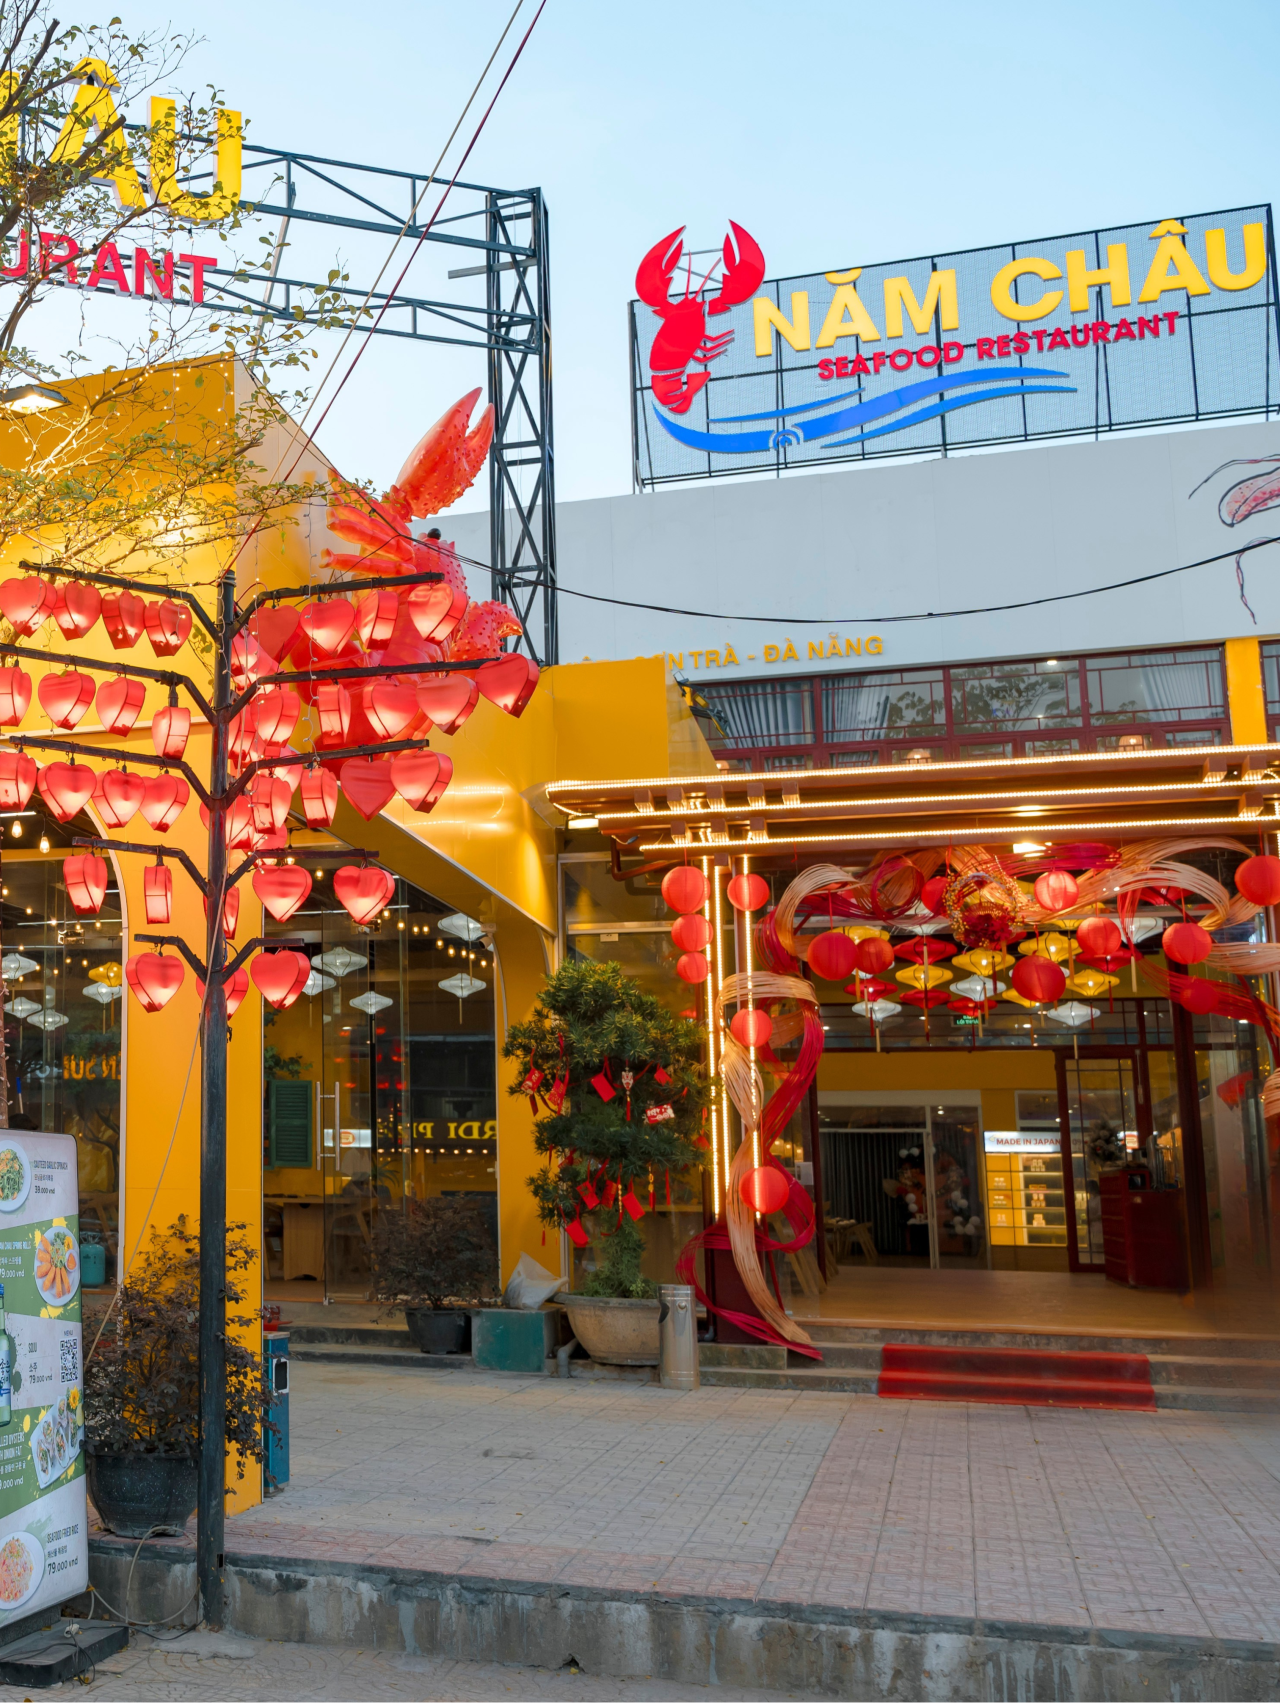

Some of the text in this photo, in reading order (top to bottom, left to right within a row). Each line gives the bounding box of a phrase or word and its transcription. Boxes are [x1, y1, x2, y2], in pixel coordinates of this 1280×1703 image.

[753, 218, 1268, 358] NĂM CHÂU
[818, 310, 1180, 382] SEAFOOD RESTAURANT
[688, 642, 740, 669] TRÀ
[763, 637, 799, 663] ĐÀ
[996, 1137, 1061, 1146] MADE IN JAPAN
[16, 1268, 25, 1277] vnd
[14, 1475, 24, 1486] vnd
[47, 1555, 79, 1576] 79.000 vnd
